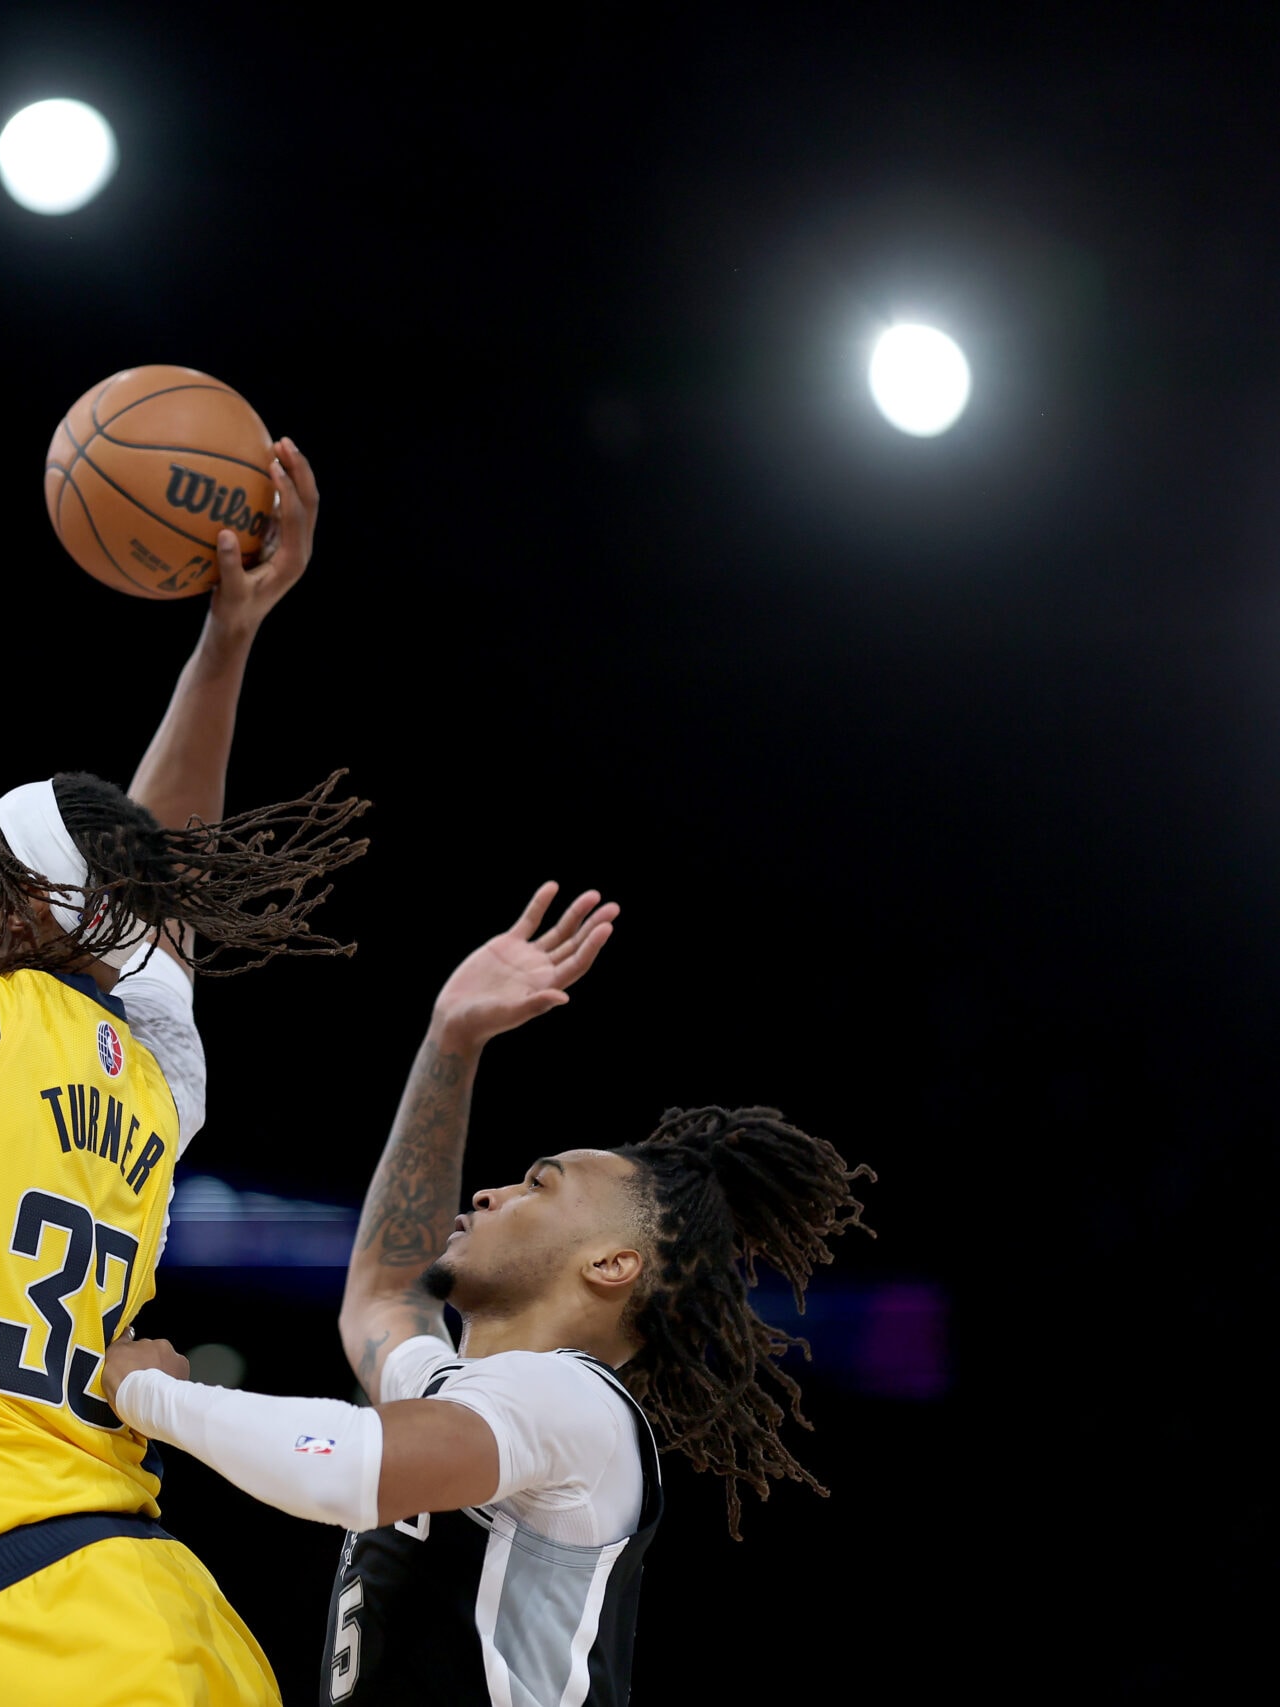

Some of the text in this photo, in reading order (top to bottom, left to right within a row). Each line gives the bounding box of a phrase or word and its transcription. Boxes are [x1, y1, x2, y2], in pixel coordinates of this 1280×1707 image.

[166, 463, 270, 536] Wilso
[40, 1084, 165, 1196] TURNER
[329, 1575, 364, 1705] 5
